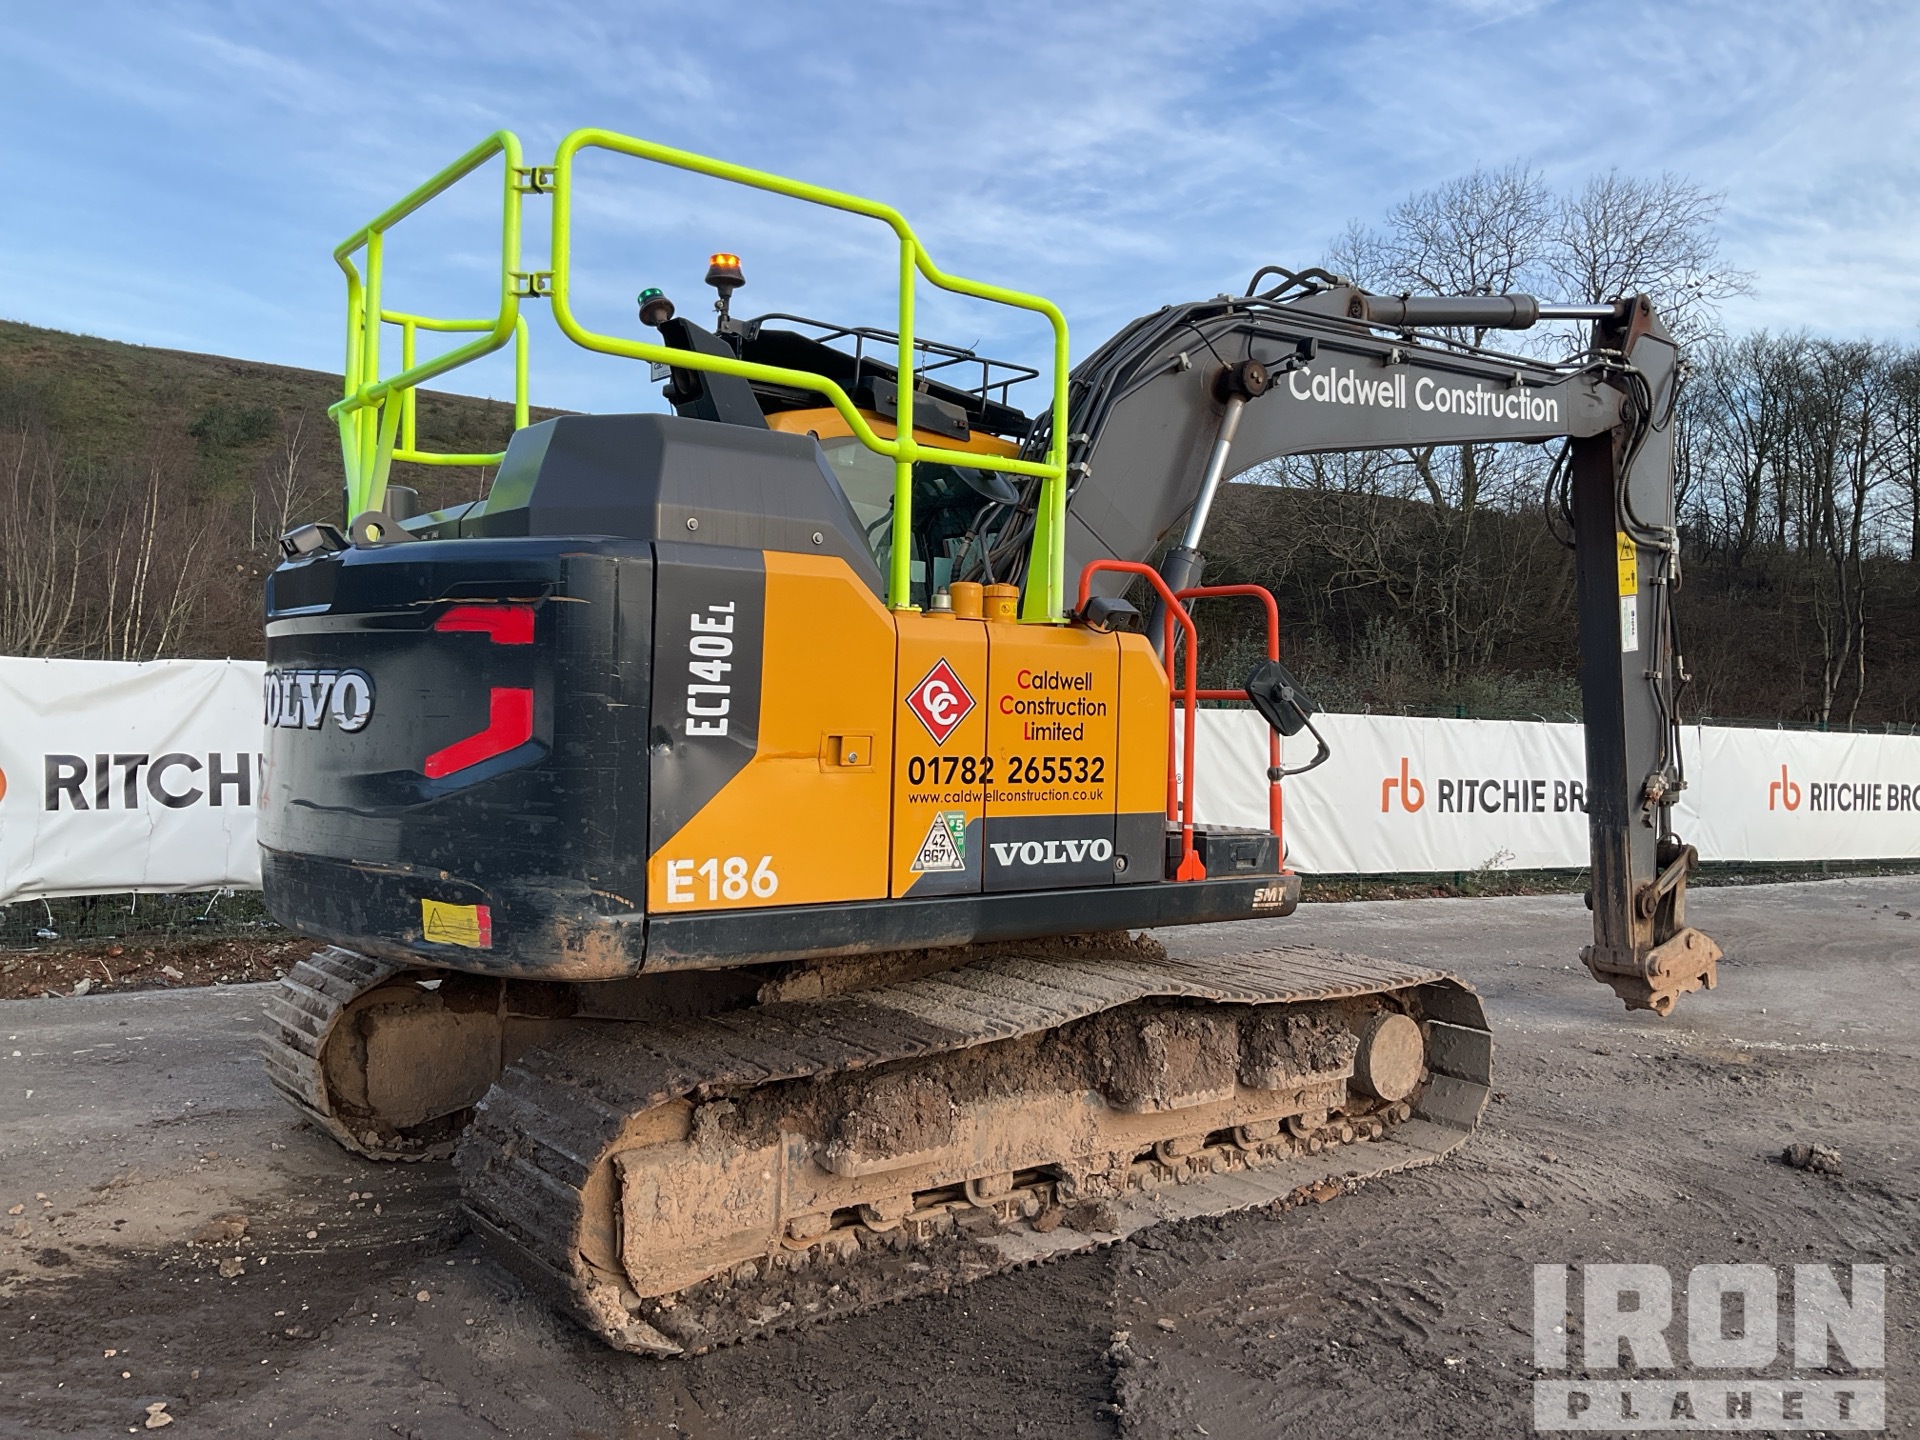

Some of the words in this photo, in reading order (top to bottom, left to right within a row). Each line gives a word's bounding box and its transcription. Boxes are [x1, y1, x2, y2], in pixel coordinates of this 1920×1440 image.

[1288, 367, 1406, 409] Caldwell
[1415, 376, 1559, 422] Construction
[1017, 669, 1093, 692] Caldwell
[999, 695, 1107, 717] Construction
[1023, 722, 1084, 742] Limited
[908, 756, 994, 785] 01782
[1007, 756, 1105, 784] 265532
[908, 788, 1104, 804] www.caldwellconstruction.co.uk
[1438, 779, 1547, 813] RITCHIE
[1810, 782, 1882, 812] RITCHIE
[931, 834, 946, 848] 42
[990, 838, 1113, 866] VOLVO
[667, 855, 779, 903] E186
[1253, 886, 1287, 902] SMT
